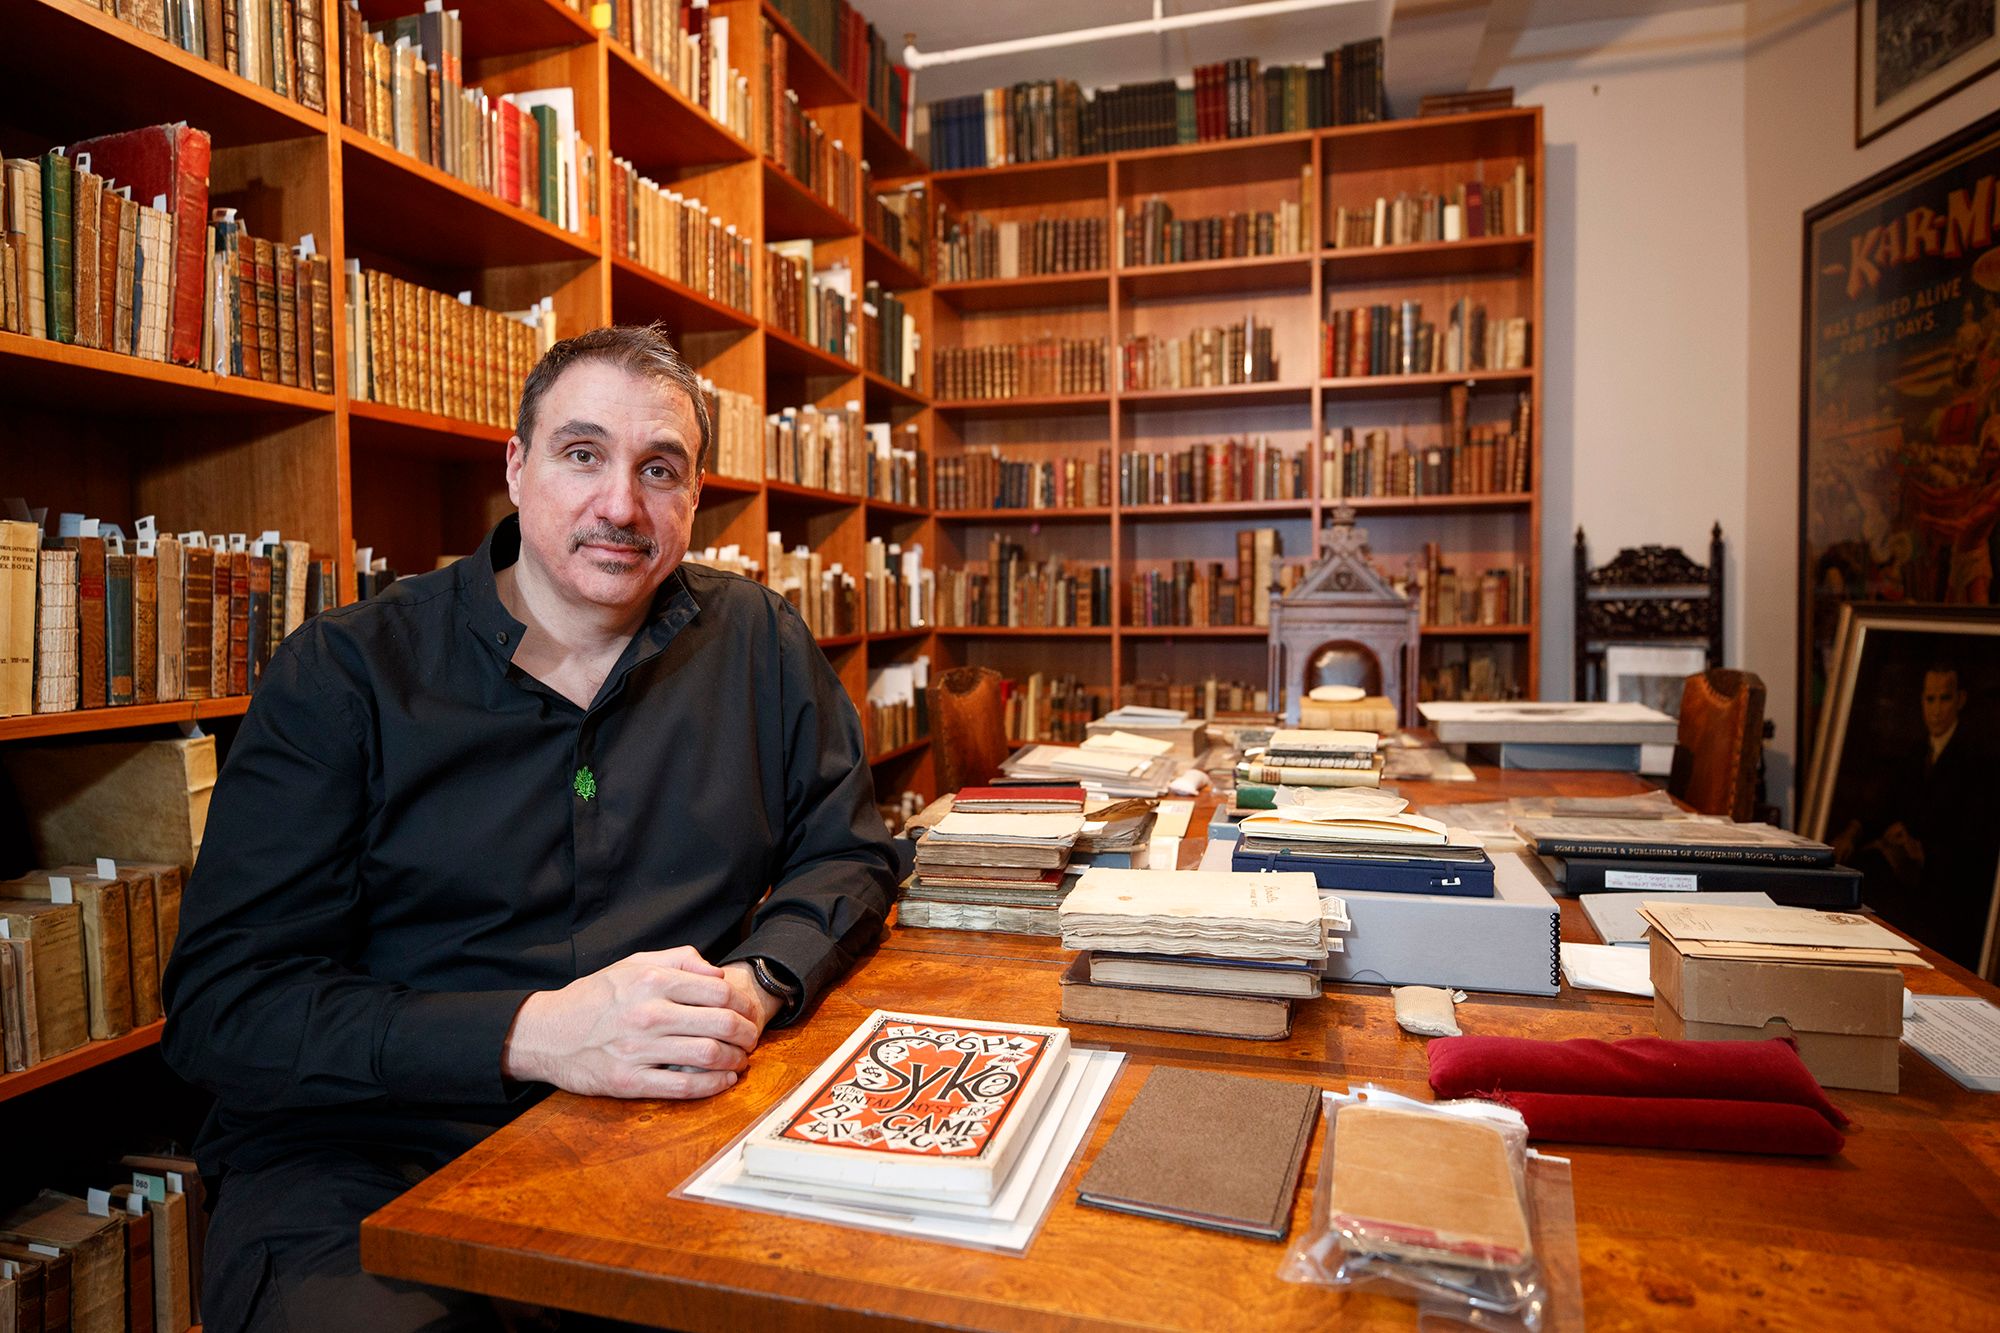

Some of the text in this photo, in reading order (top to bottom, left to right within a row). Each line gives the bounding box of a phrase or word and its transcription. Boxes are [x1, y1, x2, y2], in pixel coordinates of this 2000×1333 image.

[1823, 276, 1962, 340] WAS BURIED ALIVE
[1554, 845, 1576, 853] SOME
[1578, 845, 1617, 855] PRINTERS
[1619, 847, 1626, 855] &
[1628, 848, 1678, 857] PUBLISHERS
[1694, 850, 1742, 859] CONJURING
[828, 1090, 989, 1116] MENTAL MYSTERY
[882, 1114, 989, 1137] GAME
